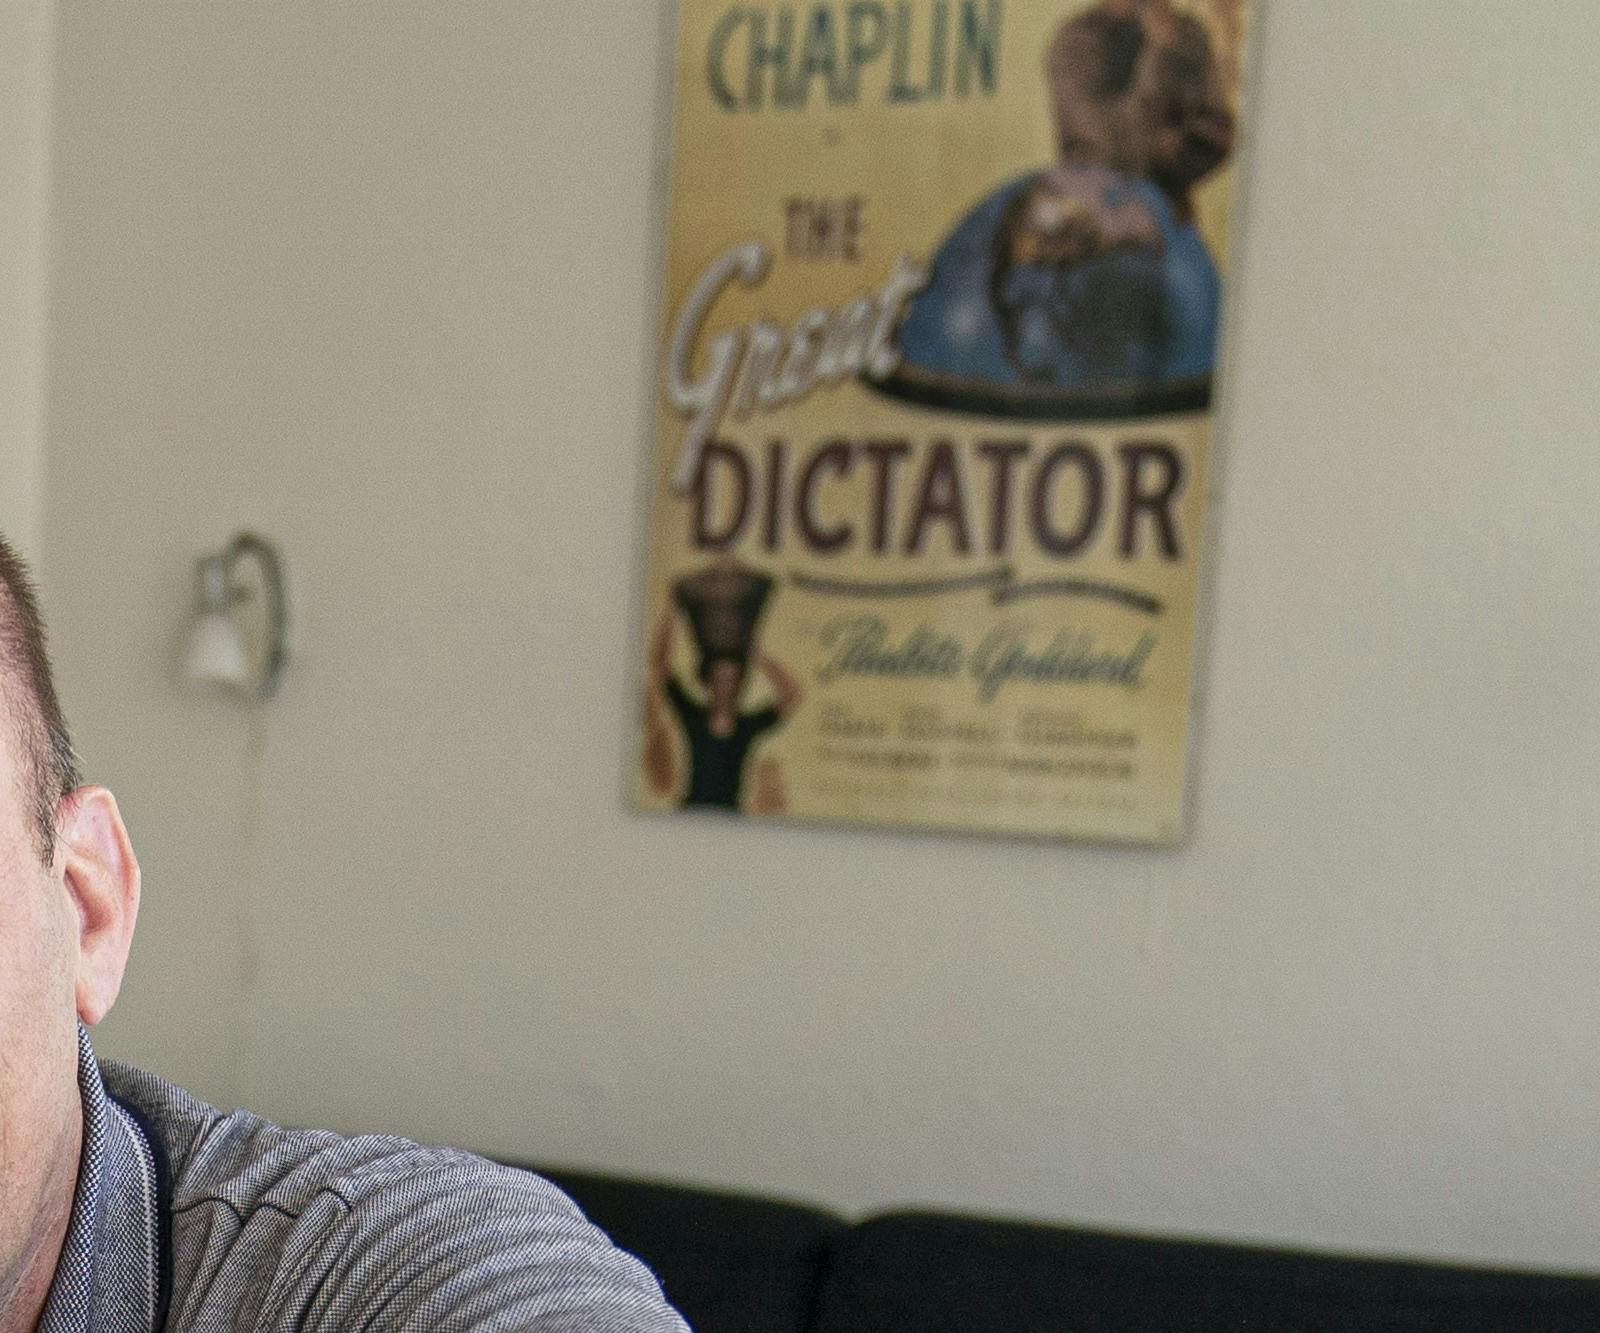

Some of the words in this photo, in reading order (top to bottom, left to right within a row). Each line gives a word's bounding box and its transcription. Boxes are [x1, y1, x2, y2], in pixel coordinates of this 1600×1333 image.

[705, 0, 1003, 115] CHAPLIN
[784, 196, 865, 262] THE
[670, 241, 932, 492] Great
[692, 437, 1187, 562] DICTATOR
